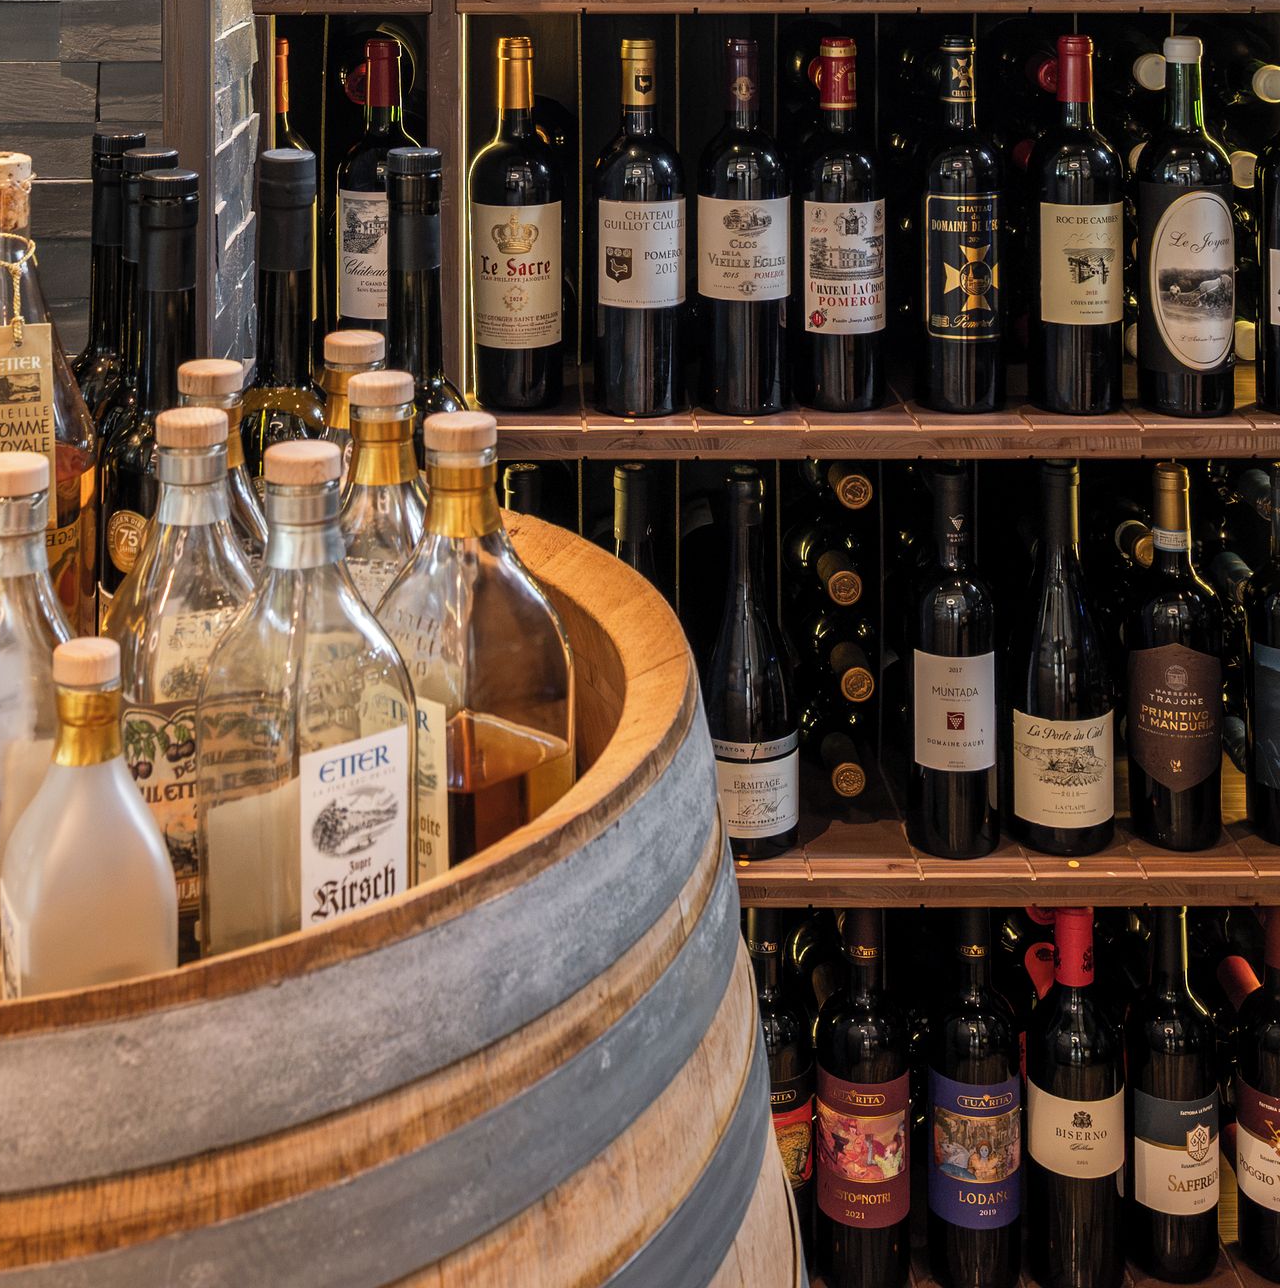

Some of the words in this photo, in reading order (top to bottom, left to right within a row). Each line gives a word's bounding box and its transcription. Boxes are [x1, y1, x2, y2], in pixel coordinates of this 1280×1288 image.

[624, 209, 674, 220] CHATEAU
[1056, 216, 1075, 224] ROC
[1090, 216, 1118, 224] CAMBES
[604, 219, 650, 230] GUILLOT
[932, 220, 968, 233] DOMAINE
[730, 239, 758, 248] CLOS
[1169, 231, 1189, 248] Le
[1191, 230, 1230, 254] Joyau
[480, 255, 498, 277] Le
[506, 257, 551, 277] Sacre
[708, 252, 750, 269] VIEILLE
[655, 262, 678, 275] 2015
[754, 269, 784, 280] POMEROL
[810, 280, 850, 296] CHÂTEAU
[853, 280, 864, 295] LA
[819, 295, 880, 308] POMEROL
[120, 528, 139, 547] 75
[932, 685, 978, 698] MUNTADA
[1155, 688, 1198, 697] MASSERIA
[1148, 693, 1204, 707] TRAJONE
[1142, 704, 1210, 721] PRIMITIVO
[1026, 724, 1040, 737] La
[1042, 725, 1071, 743] Porte
[1072, 726, 1085, 742] du
[1086, 722, 1105, 739] Ciel
[1150, 718, 1214, 734] MANDURIA
[927, 738, 960, 748] DOMAINE
[963, 738, 986, 748] GAUBY
[320, 744, 390, 784] ETTER
[734, 778, 781, 790] ERMITAGE
[312, 858, 396, 920] Kirsch
[856, 1096, 880, 1104] RITA
[963, 1096, 985, 1108] TUA
[988, 1095, 1009, 1107] RITA
[1056, 1126, 1108, 1142] BISERNO
[1239, 1152, 1274, 1186] POGGIO
[862, 1191, 891, 1205] NOTRI
[844, 1209, 865, 1220] 2021
[979, 1208, 997, 1217] 2019
